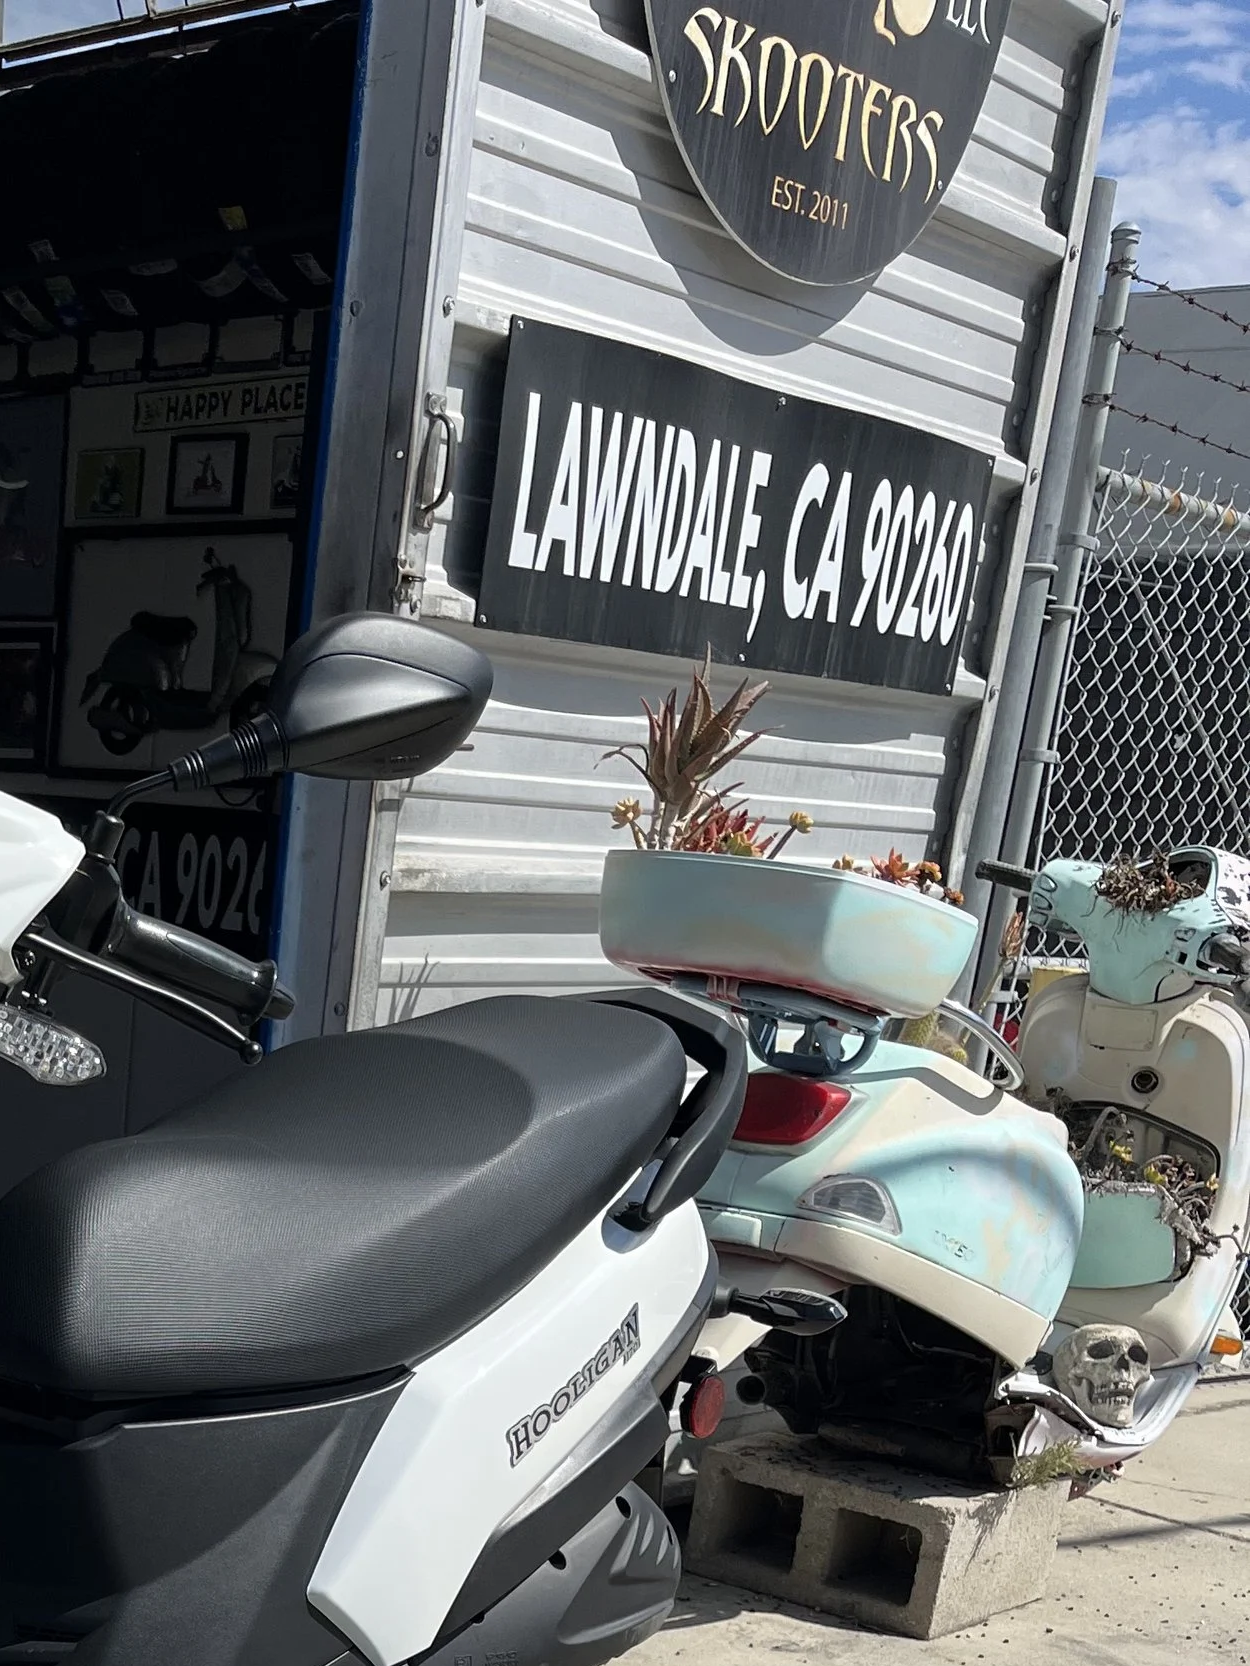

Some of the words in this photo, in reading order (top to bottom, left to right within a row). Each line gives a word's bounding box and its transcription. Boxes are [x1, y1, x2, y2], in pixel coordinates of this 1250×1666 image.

[684, 7, 945, 204] SKOOTERS
[771, 176, 806, 216] EST.
[808, 190, 849, 230] 2011
[166, 390, 232, 423] HAPPY
[240, 382, 306, 416] PLACE
[508, 392, 772, 643] LAWNDALE,
[783, 463, 853, 624] CA
[850, 478, 974, 646] 90260
[509, 1306, 640, 1464] HOOLIGAN
